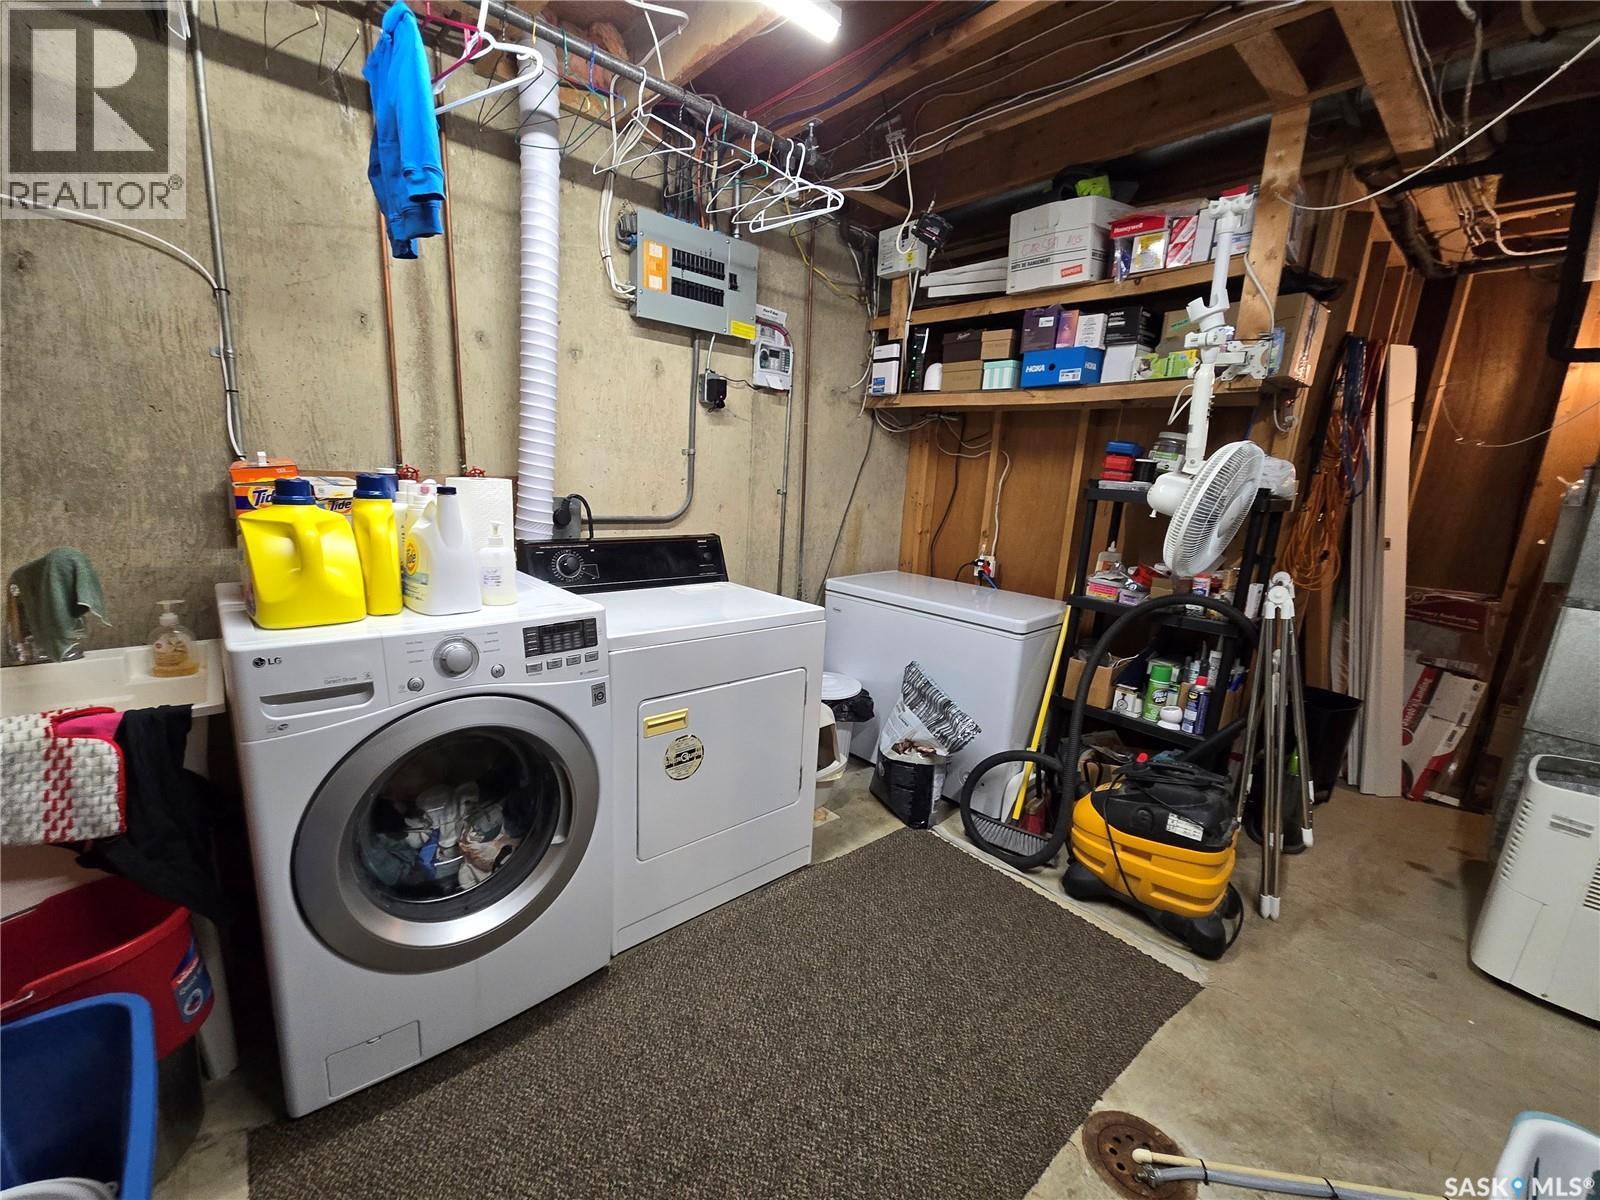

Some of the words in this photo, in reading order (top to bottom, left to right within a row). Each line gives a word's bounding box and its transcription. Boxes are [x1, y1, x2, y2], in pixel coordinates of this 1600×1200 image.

[1113, 222, 1143, 233] Honeywell
[1025, 364, 1045, 373] HOKA
[328, 500, 352, 511] Tide
[267, 657, 282, 665] LG
